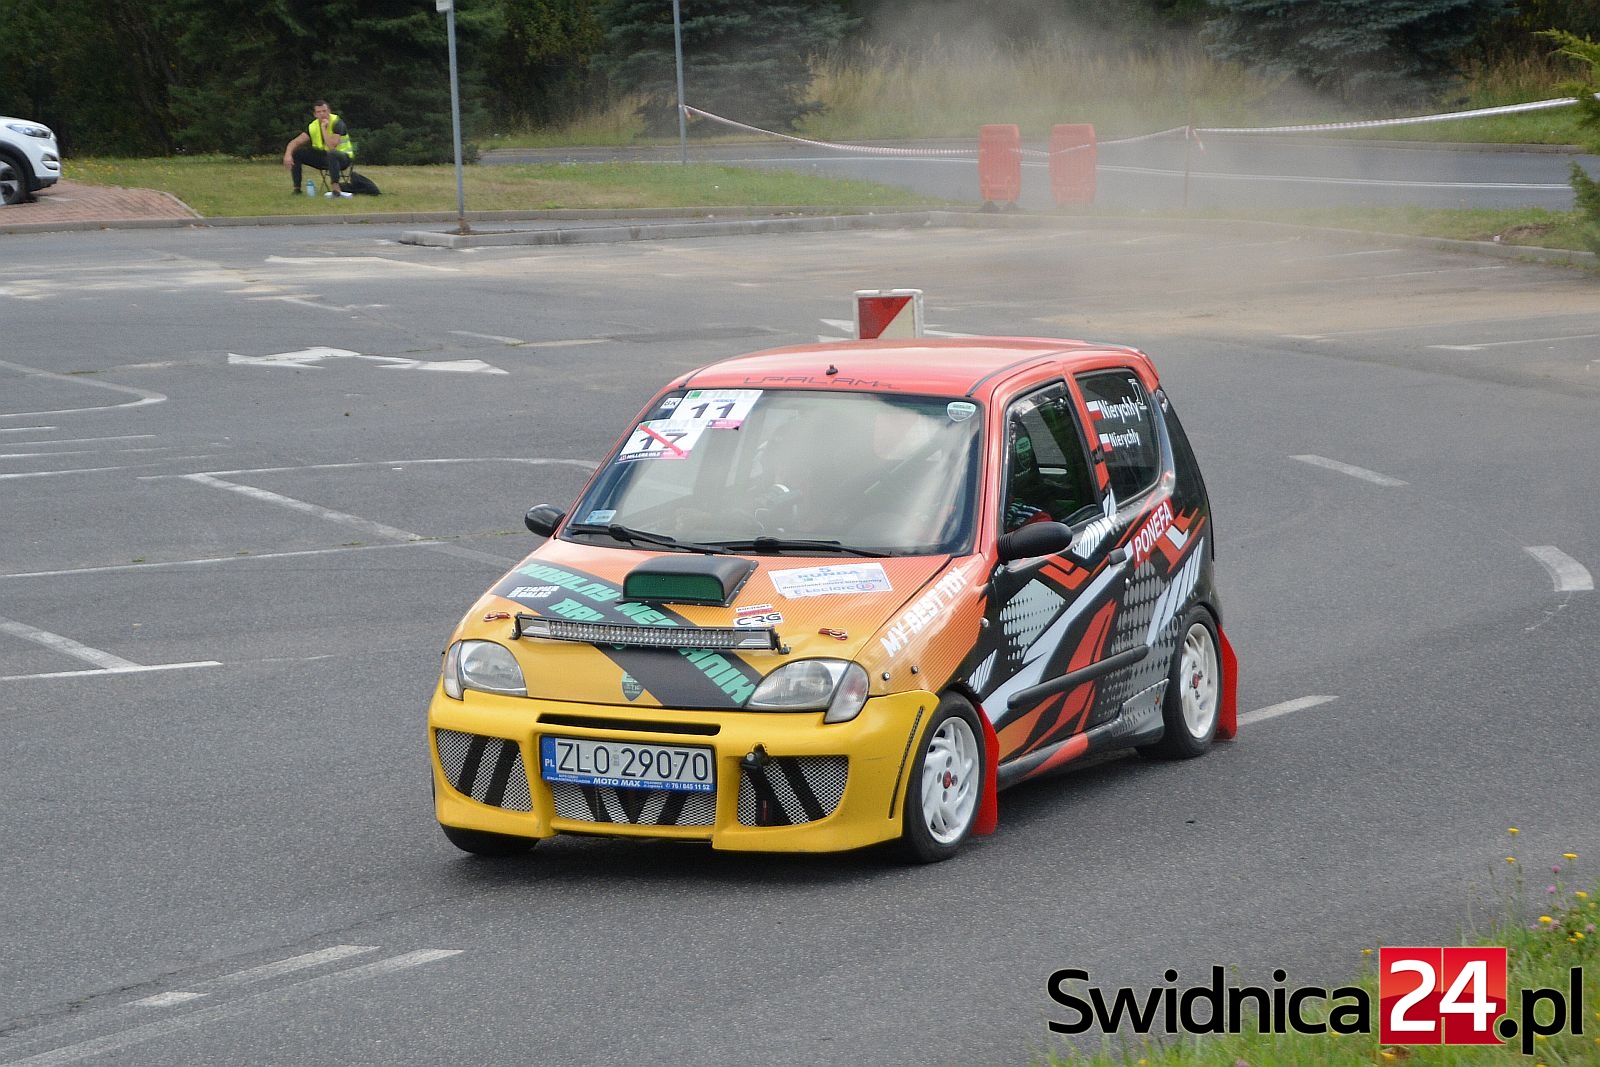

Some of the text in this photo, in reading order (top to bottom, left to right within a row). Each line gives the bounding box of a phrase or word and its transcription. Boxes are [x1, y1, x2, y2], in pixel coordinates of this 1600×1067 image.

[691, 403, 736, 419] 11
[1133, 500, 1173, 562] PONEFA
[736, 612, 782, 627] CRG
[880, 621, 909, 658] MY
[903, 588, 945, 635] BEST
[544, 758, 555, 768] PL
[557, 741, 708, 781] ZLO 29070
[593, 777, 619, 786] MOTO
[621, 779, 641, 787] MAX
